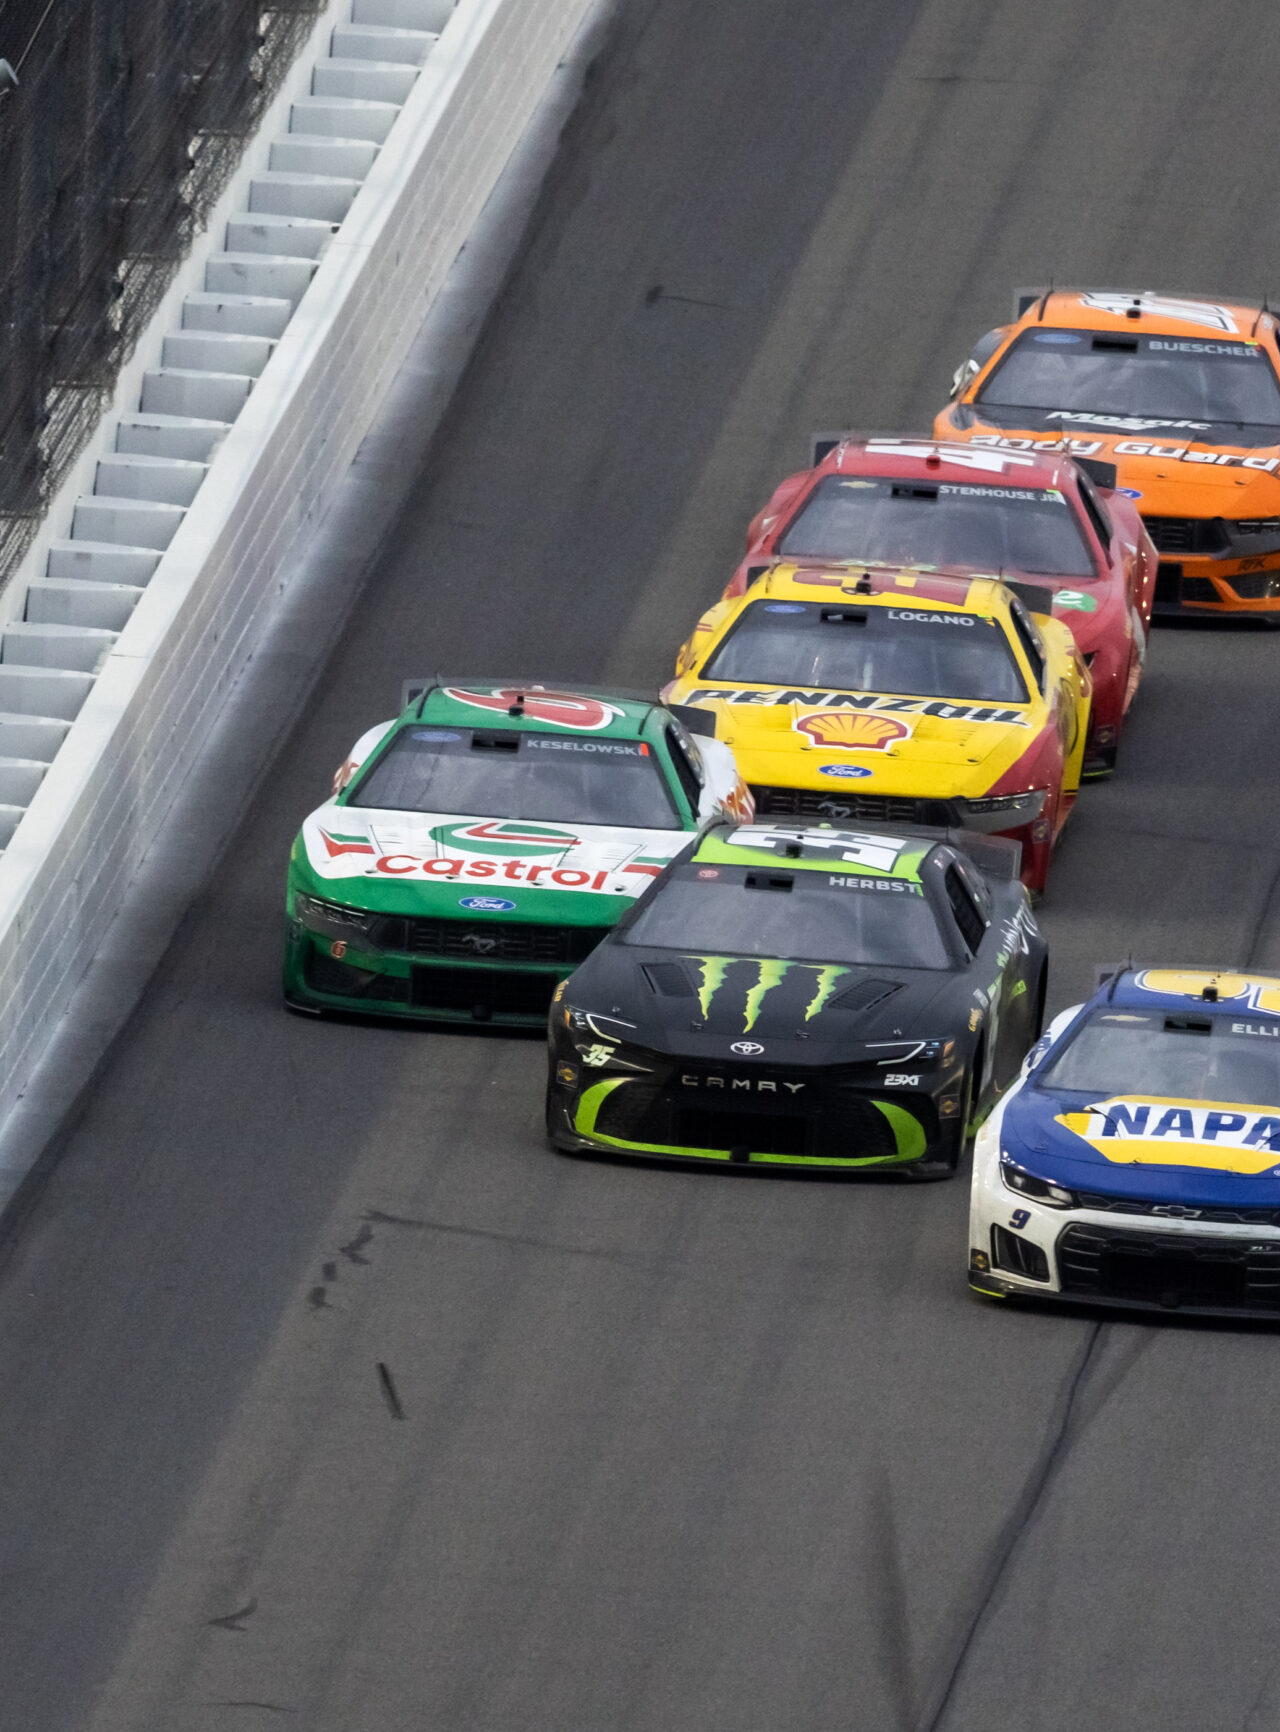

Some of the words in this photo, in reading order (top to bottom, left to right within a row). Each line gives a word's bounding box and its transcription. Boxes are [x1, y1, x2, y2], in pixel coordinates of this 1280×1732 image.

[1149, 341, 1259, 358] BUESCHER
[939, 484, 1038, 501] STENHOUSE
[888, 610, 975, 627] LOGANO
[527, 739, 643, 756] KESELOWSKI
[828, 765, 866, 778] Ford
[376, 854, 609, 891] Castrol
[829, 876, 917, 894] HERBST
[467, 897, 505, 910] Ford
[330, 940, 348, 959] 6
[582, 1044, 616, 1067] 35
[682, 1075, 806, 1093] CAMRY
[1008, 1208, 1032, 1230] 9
